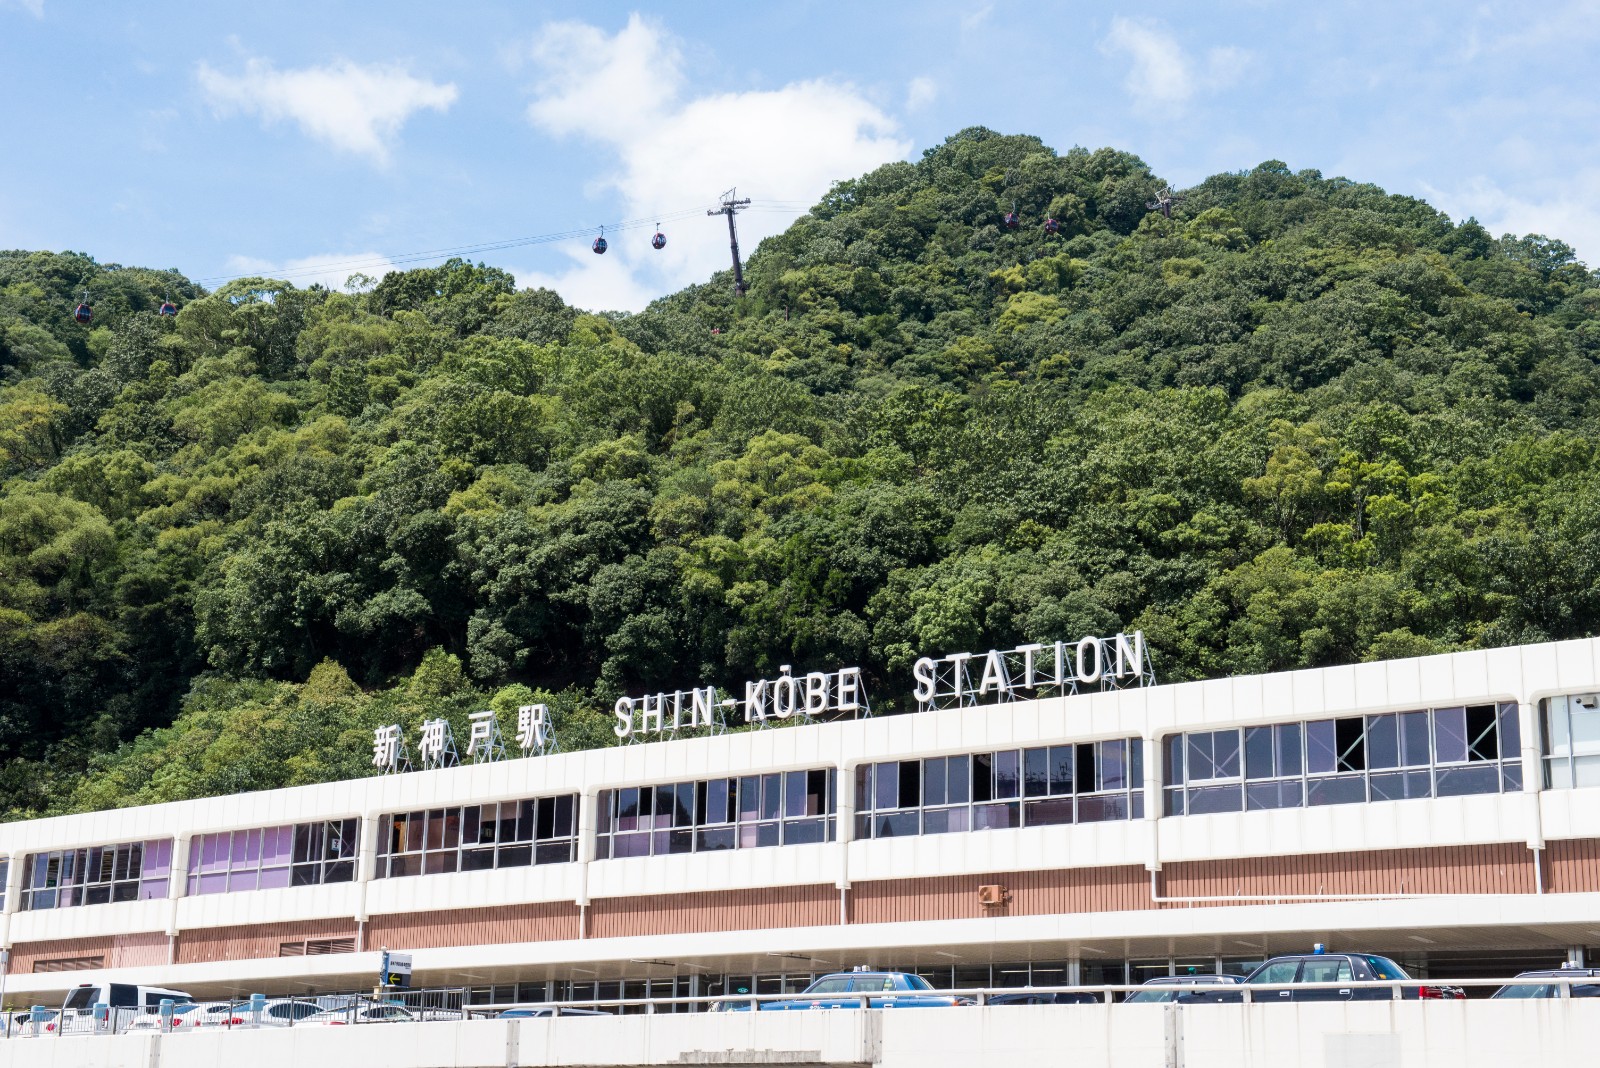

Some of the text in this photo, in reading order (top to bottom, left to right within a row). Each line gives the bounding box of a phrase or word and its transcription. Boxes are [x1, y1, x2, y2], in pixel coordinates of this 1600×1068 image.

[913, 630, 1144, 702] STATION
[372, 703, 546, 767] 新神戸駅
